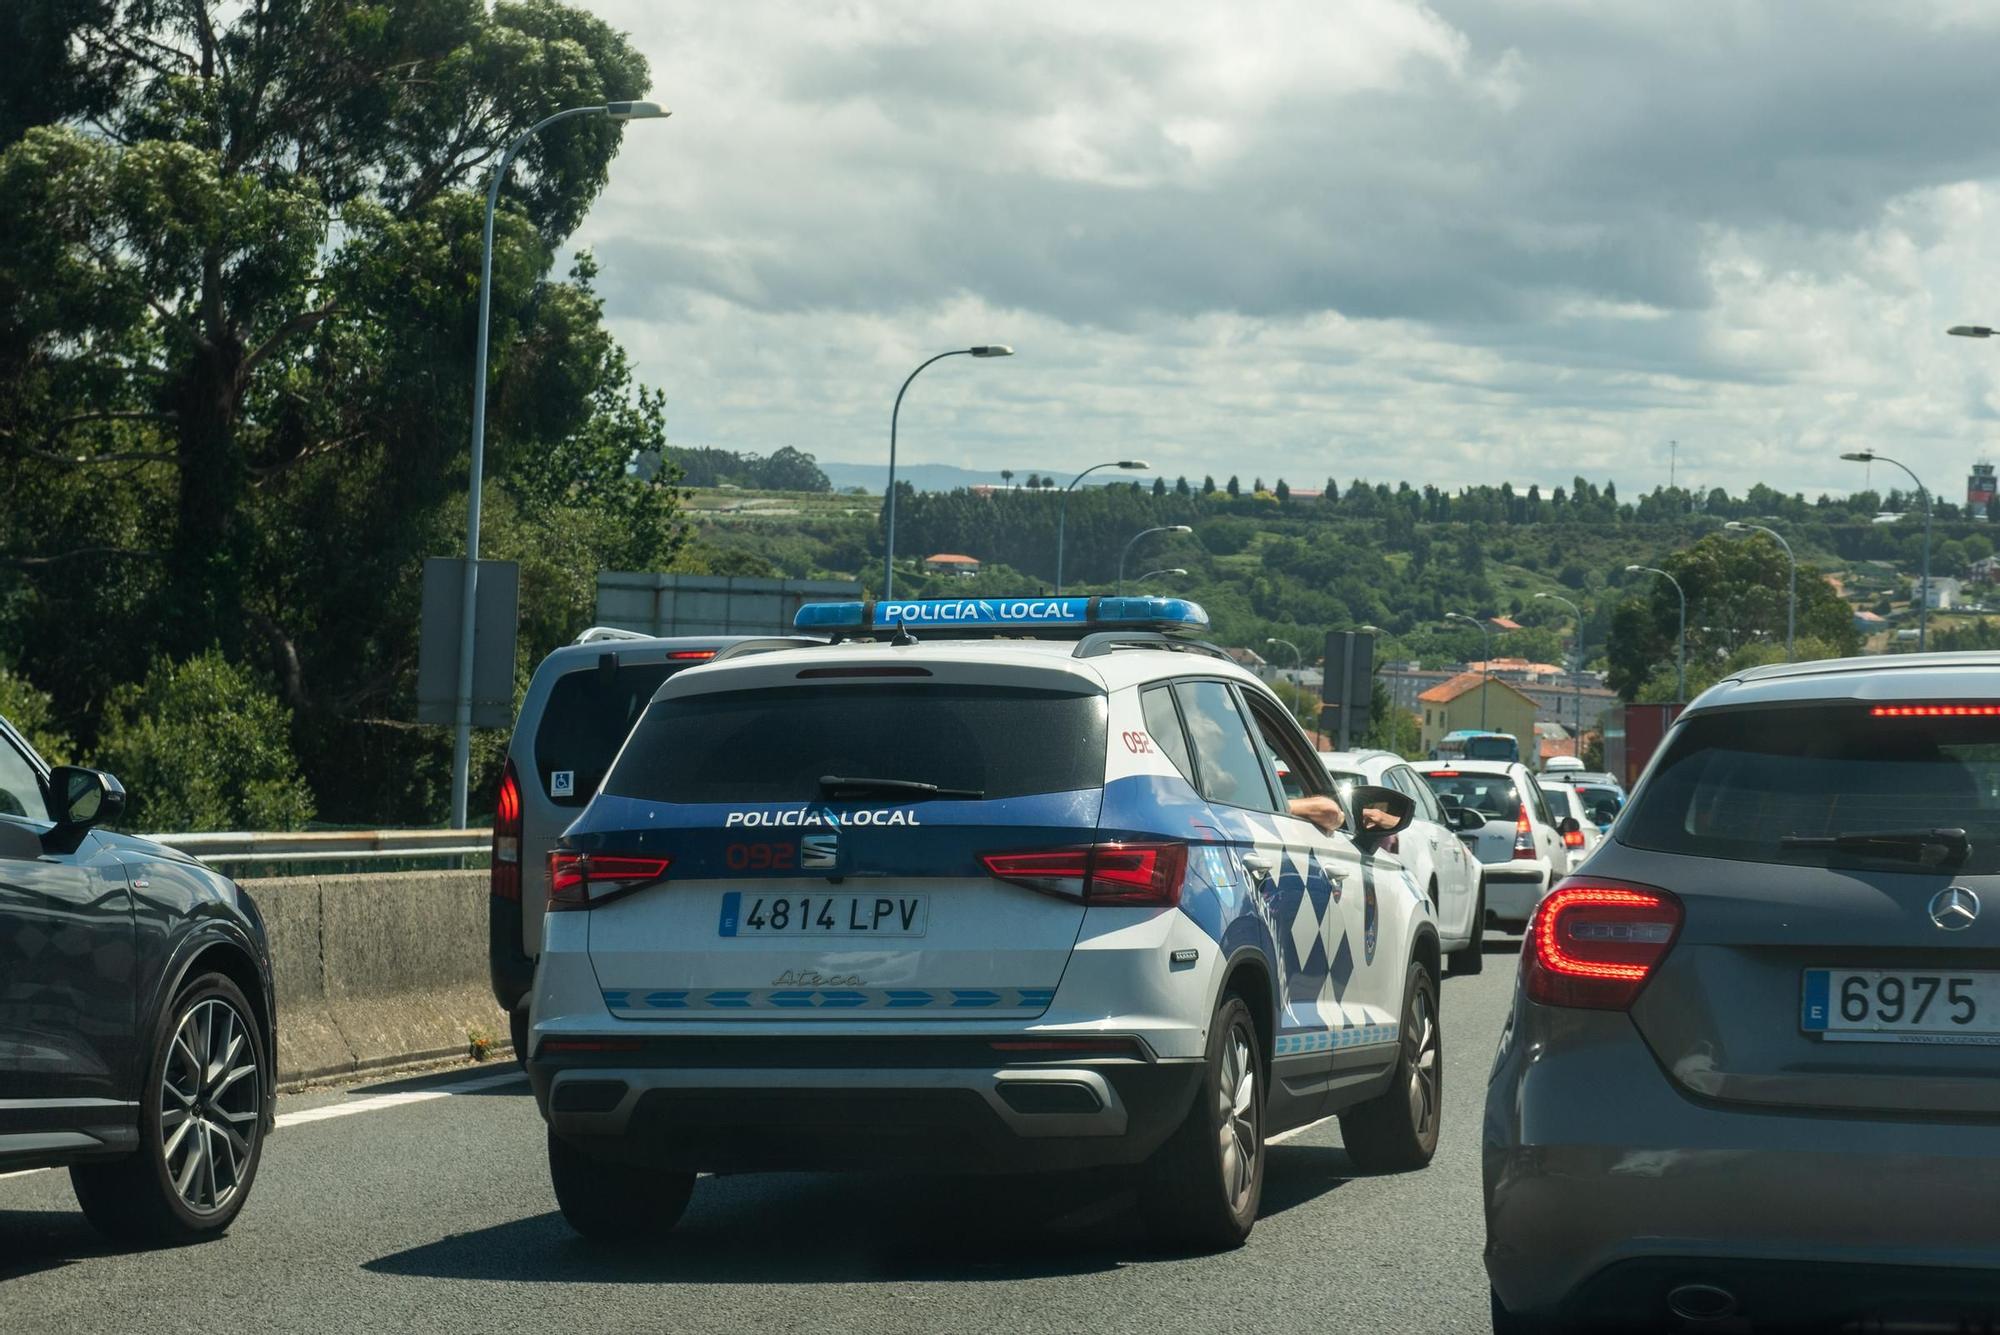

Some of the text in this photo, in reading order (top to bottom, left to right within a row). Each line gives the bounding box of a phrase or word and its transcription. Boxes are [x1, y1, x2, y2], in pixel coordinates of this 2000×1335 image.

[885, 601, 1075, 621] POLICÍA LOCAL
[725, 807, 921, 828] POLICÍA LOCAL
[726, 843, 796, 869] 092
[747, 898, 919, 930] 4814 LPV
[771, 968, 868, 987] Ateca
[1841, 975, 1976, 1025] 6975
[1811, 1005, 1823, 1019] E
